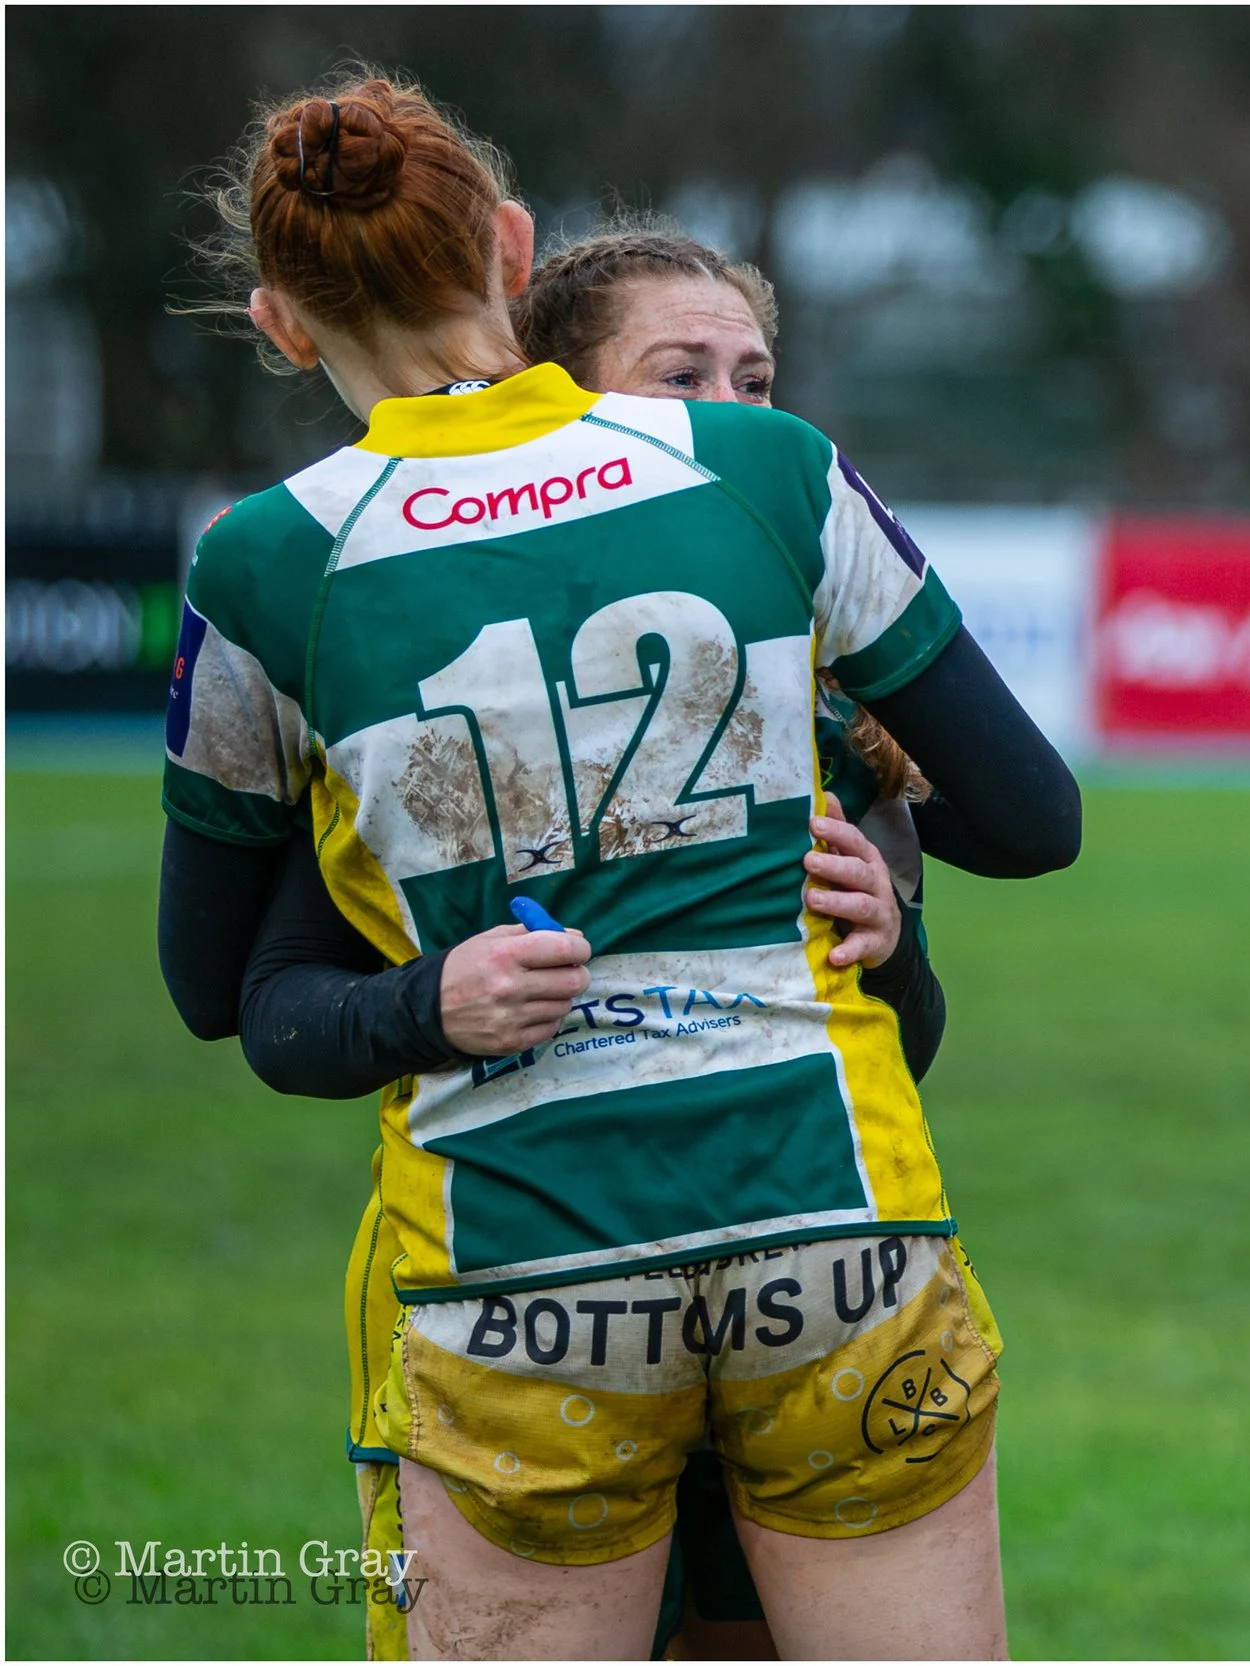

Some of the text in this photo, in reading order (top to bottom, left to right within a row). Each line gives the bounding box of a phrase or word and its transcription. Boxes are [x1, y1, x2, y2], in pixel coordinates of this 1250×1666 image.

[402, 457, 633, 531] Compra
[417, 589, 752, 885] 12
[554, 1013, 742, 1058] Chartered Tax Advisers
[831, 1236, 908, 1325] UP
[901, 1378, 948, 1407] B B
